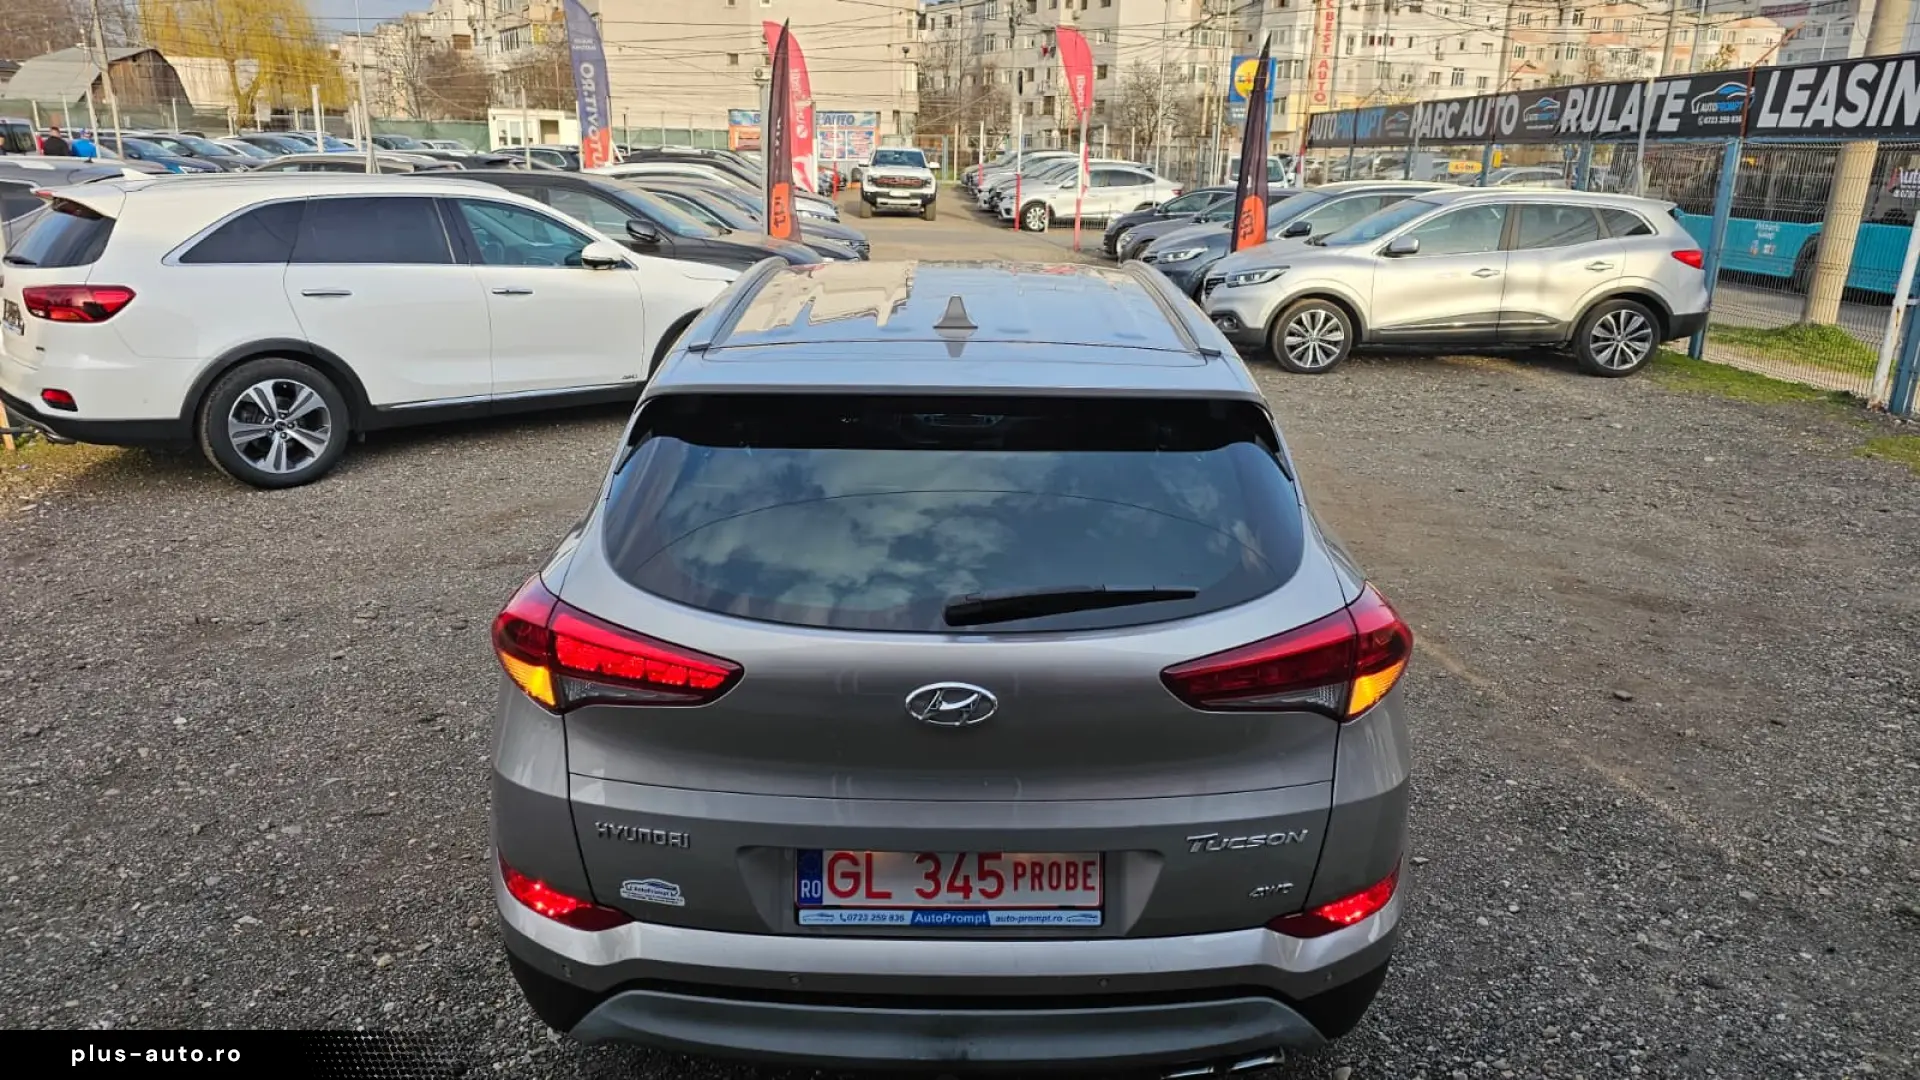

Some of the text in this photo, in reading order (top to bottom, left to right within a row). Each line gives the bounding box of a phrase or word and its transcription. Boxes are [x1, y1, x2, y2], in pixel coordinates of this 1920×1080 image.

[1314, 59, 1328, 102] AUTO
[1409, 101, 1460, 139] PARC
[1457, 95, 1519, 136] AUTO
[1560, 80, 1692, 133] RULATE
[1757, 59, 1920, 128] LEASIN
[595, 821, 691, 848] HYUNDAI
[801, 851, 1096, 900] RO GL 345 PROBE
[914, 910, 987, 925] AutoPrompt
[995, 911, 1063, 924] auto-prompt.ro
